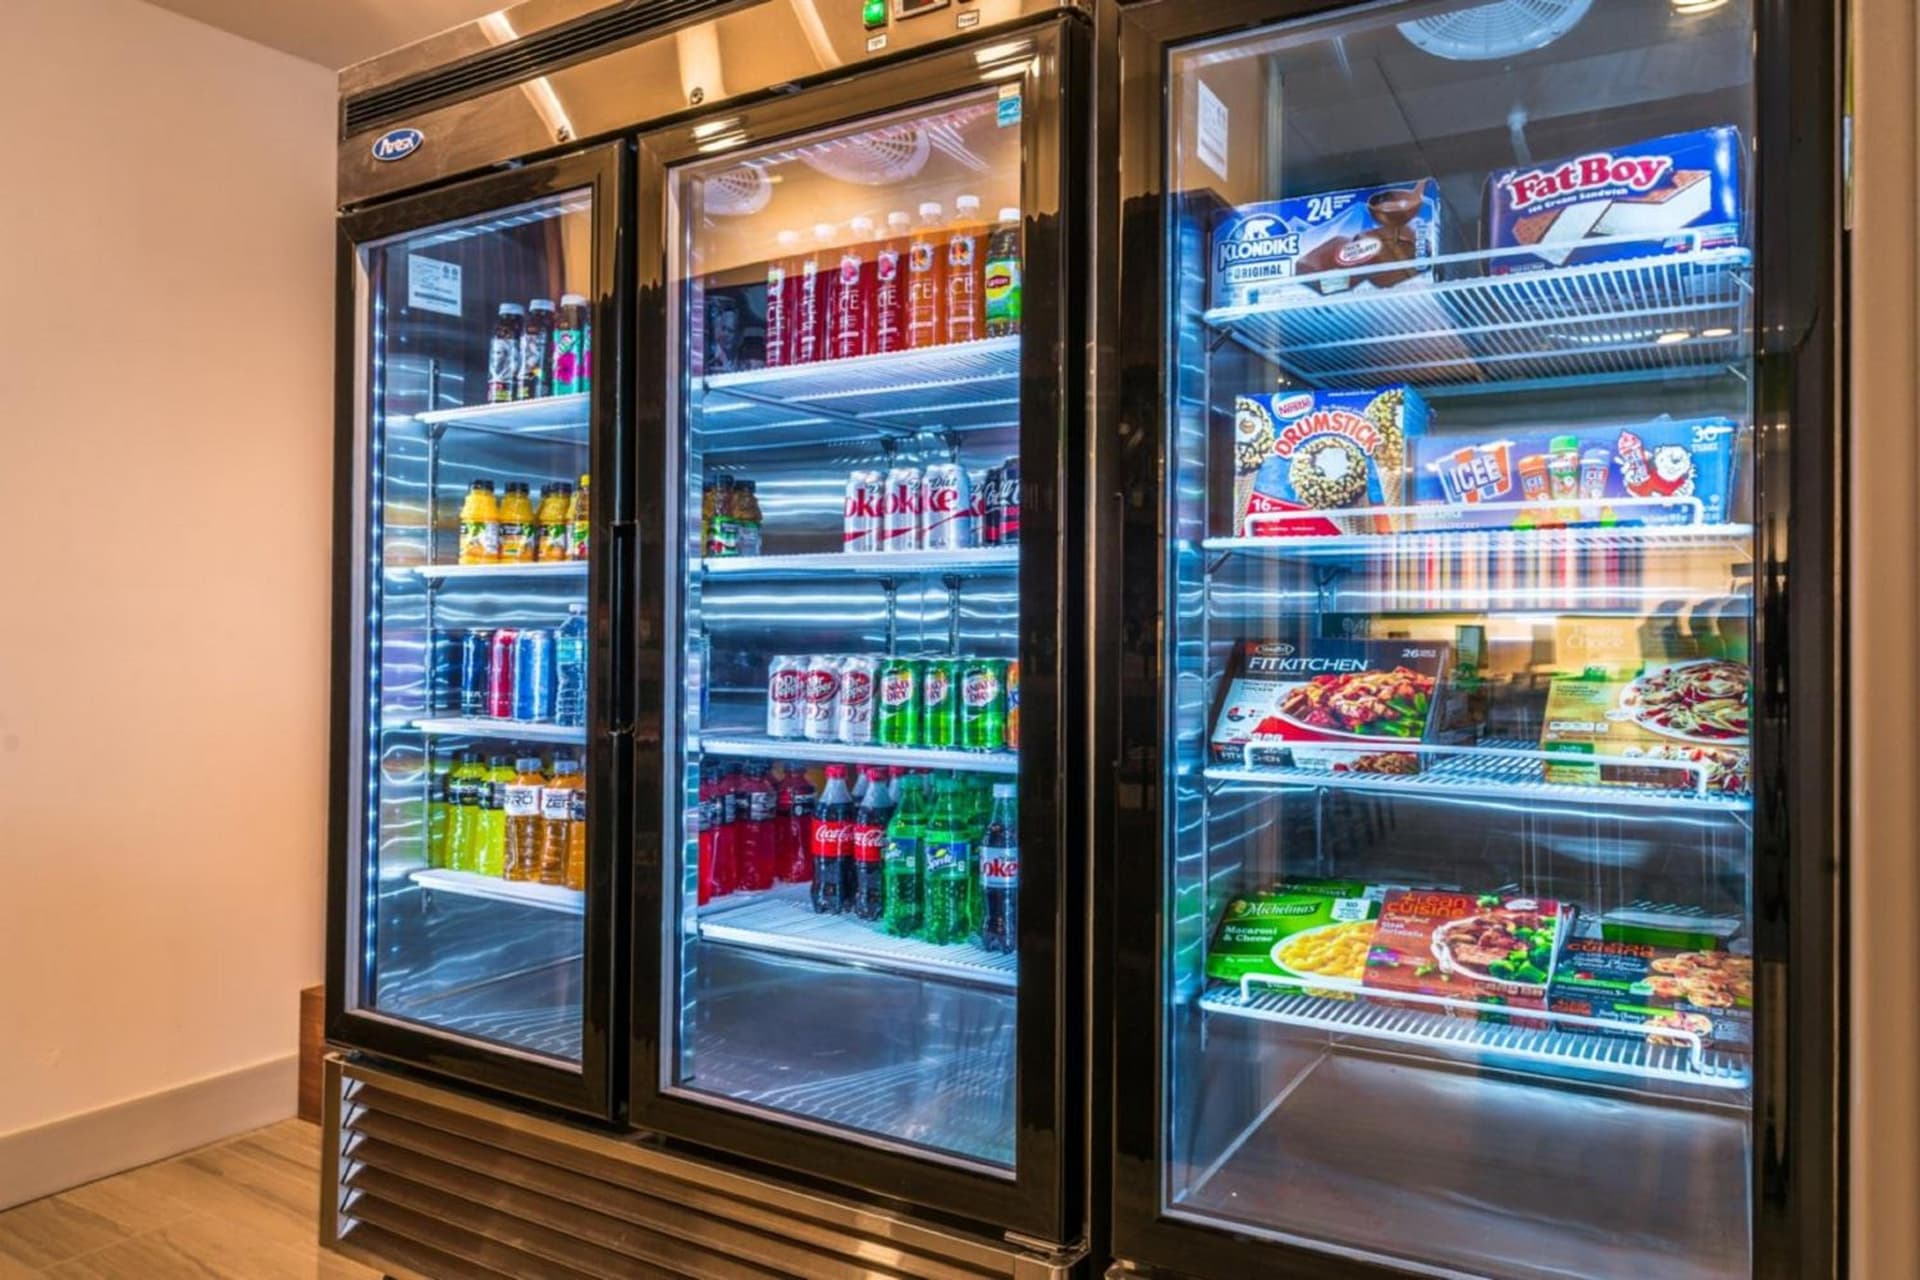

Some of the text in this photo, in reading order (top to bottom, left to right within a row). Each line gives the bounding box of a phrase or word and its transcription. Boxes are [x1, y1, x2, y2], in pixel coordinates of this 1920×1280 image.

[1510, 154, 1670, 208] FatBoy
[1580, 187, 1628, 200] Sandwich
[1306, 196, 1334, 222] 24
[1219, 233, 1299, 270] KLONDIKE
[1233, 264, 1283, 280] ORIGINAL
[1273, 411, 1384, 458] DRUMSTICK
[1691, 425, 1718, 443] 30
[1451, 453, 1502, 493] ICEE
[1252, 498, 1271, 511] 16
[1402, 649, 1419, 658] 26
[981, 858, 1019, 878] oke
[1386, 903, 1466, 918] cuisine
[1224, 926, 1278, 936] Macaroni
[1235, 934, 1273, 943] Cheese
